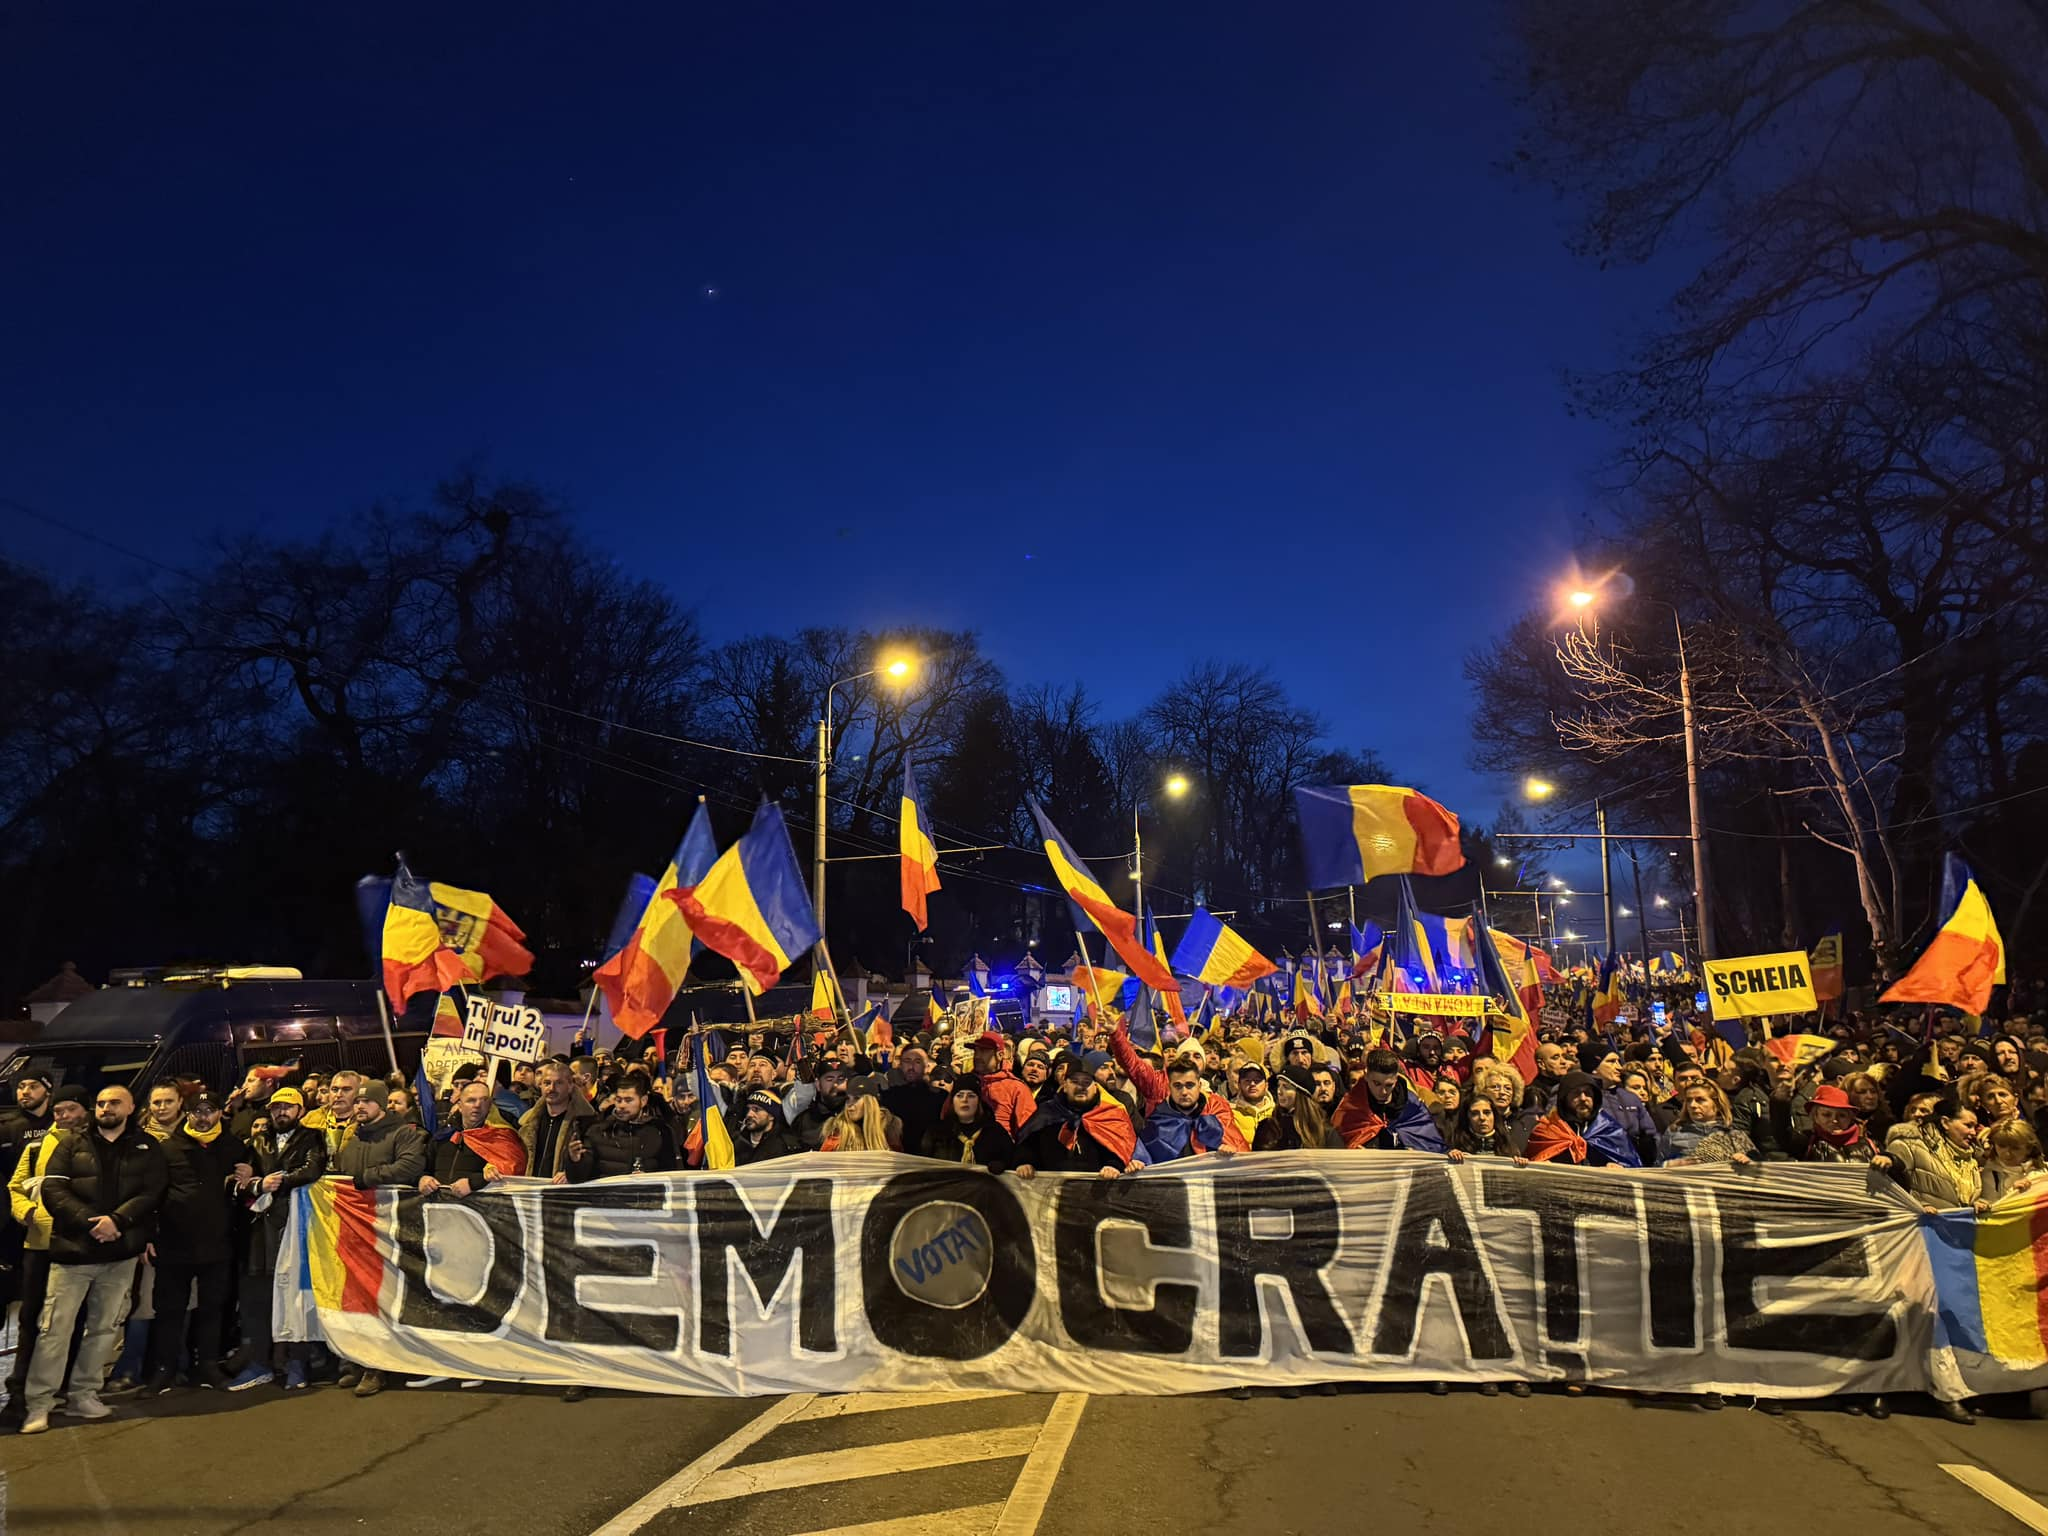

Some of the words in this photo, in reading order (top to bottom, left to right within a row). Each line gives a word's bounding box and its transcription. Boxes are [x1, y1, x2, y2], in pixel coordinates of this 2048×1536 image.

[1713, 964, 1807, 1003] ȘCHEIA
[467, 1022, 535, 1054] înapoi!
[524, 1013, 540, 1035] 2,
[391, 1168, 1904, 1381] DEMOCRAȚIE
